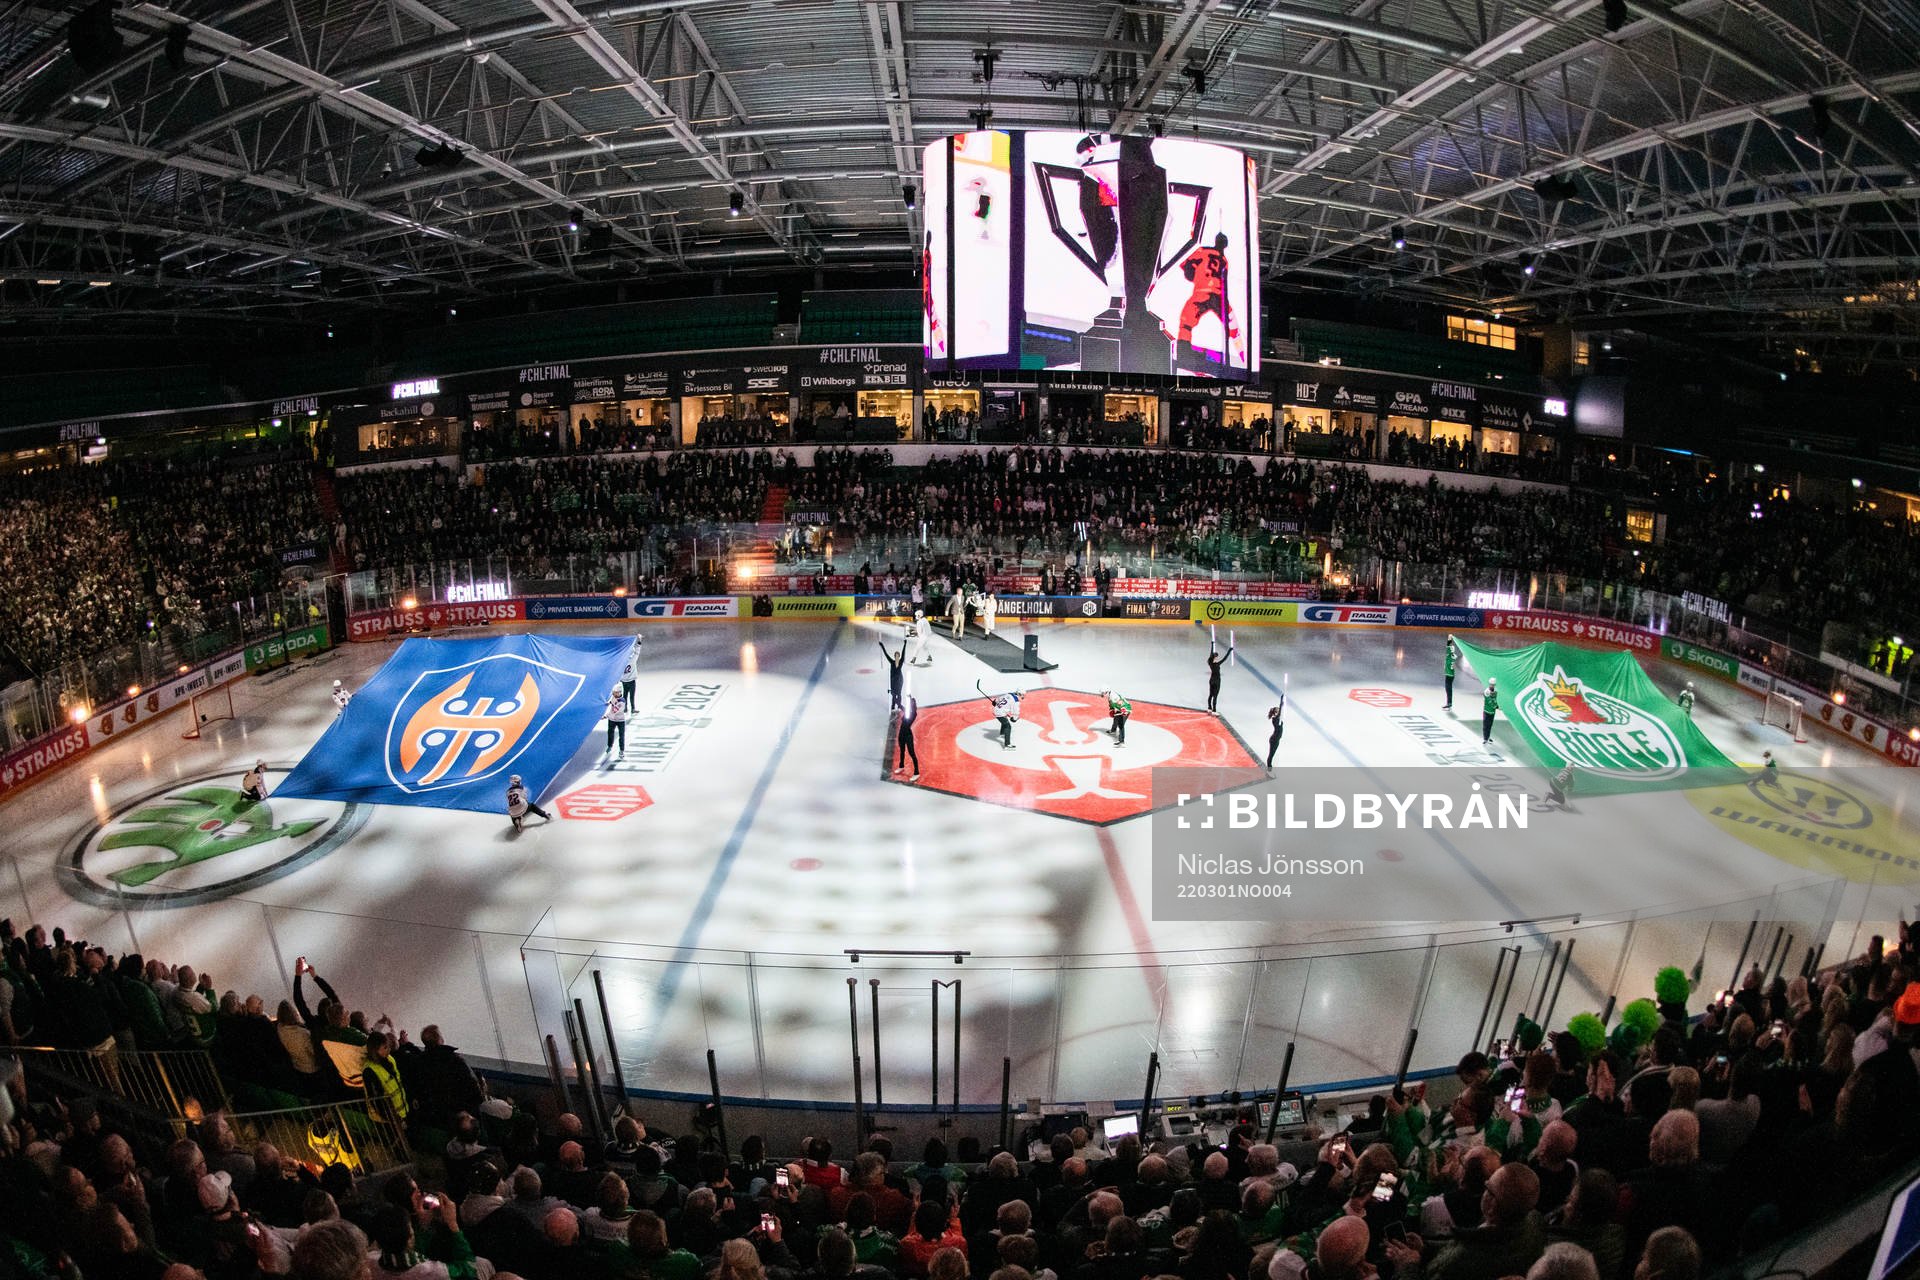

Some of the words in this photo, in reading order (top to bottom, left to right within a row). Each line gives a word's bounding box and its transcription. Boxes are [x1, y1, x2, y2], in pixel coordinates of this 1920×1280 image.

[820, 347, 882, 364] #CHLFINAL
[519, 365, 572, 383] #CHLFINAL
[873, 362, 907, 374] prenad
[393, 379, 440, 399] #CHLFINAL
[747, 377, 780, 389] SSE
[812, 376, 856, 387] Wihlborgs
[1225, 385, 1244, 397] EY
[1395, 391, 1422, 404] GPA
[1431, 382, 1477, 401] #CHLFINAL
[272, 397, 320, 415] #CHLFINAL
[59, 421, 102, 441] #CHLFINAL
[790, 512, 831, 523] #CHLFINAL
[1263, 521, 1300, 532] #CHLFINAL
[282, 548, 317, 563] #CHLFINAL
[448, 583, 508, 603] #CHLFINAL
[1468, 591, 1521, 610] #CHLFINAL
[446, 604, 518, 623] STRAUSS
[634, 599, 731, 616] GT
[776, 602, 838, 611] WARRIOR
[865, 601, 887, 612] FINAL
[997, 599, 1053, 615] ÄNGELHOLM
[1126, 603, 1147, 615] FINAL
[1161, 604, 1181, 615] 2022
[1227, 607, 1283, 616] WARRIOR
[1303, 606, 1392, 622] GT
[1680, 590, 1729, 623] #CHLFINAL
[352, 611, 426, 635] STRAUSS
[1506, 615, 1569, 634] STRAUSS
[1588, 624, 1653, 650] STRAUSS
[268, 634, 318, 657] ŠKODA
[1687, 648, 1731, 674] ŠKODA
[663, 684, 722, 711] 2022
[1390, 715, 1461, 747] FINAL
[14, 730, 84, 780] STRAUSS
[606, 733, 683, 772] FINAL
[1548, 727, 1663, 771] RÖGLE
[507, 793, 520, 807] 22
[566, 786, 643, 818] CHL
